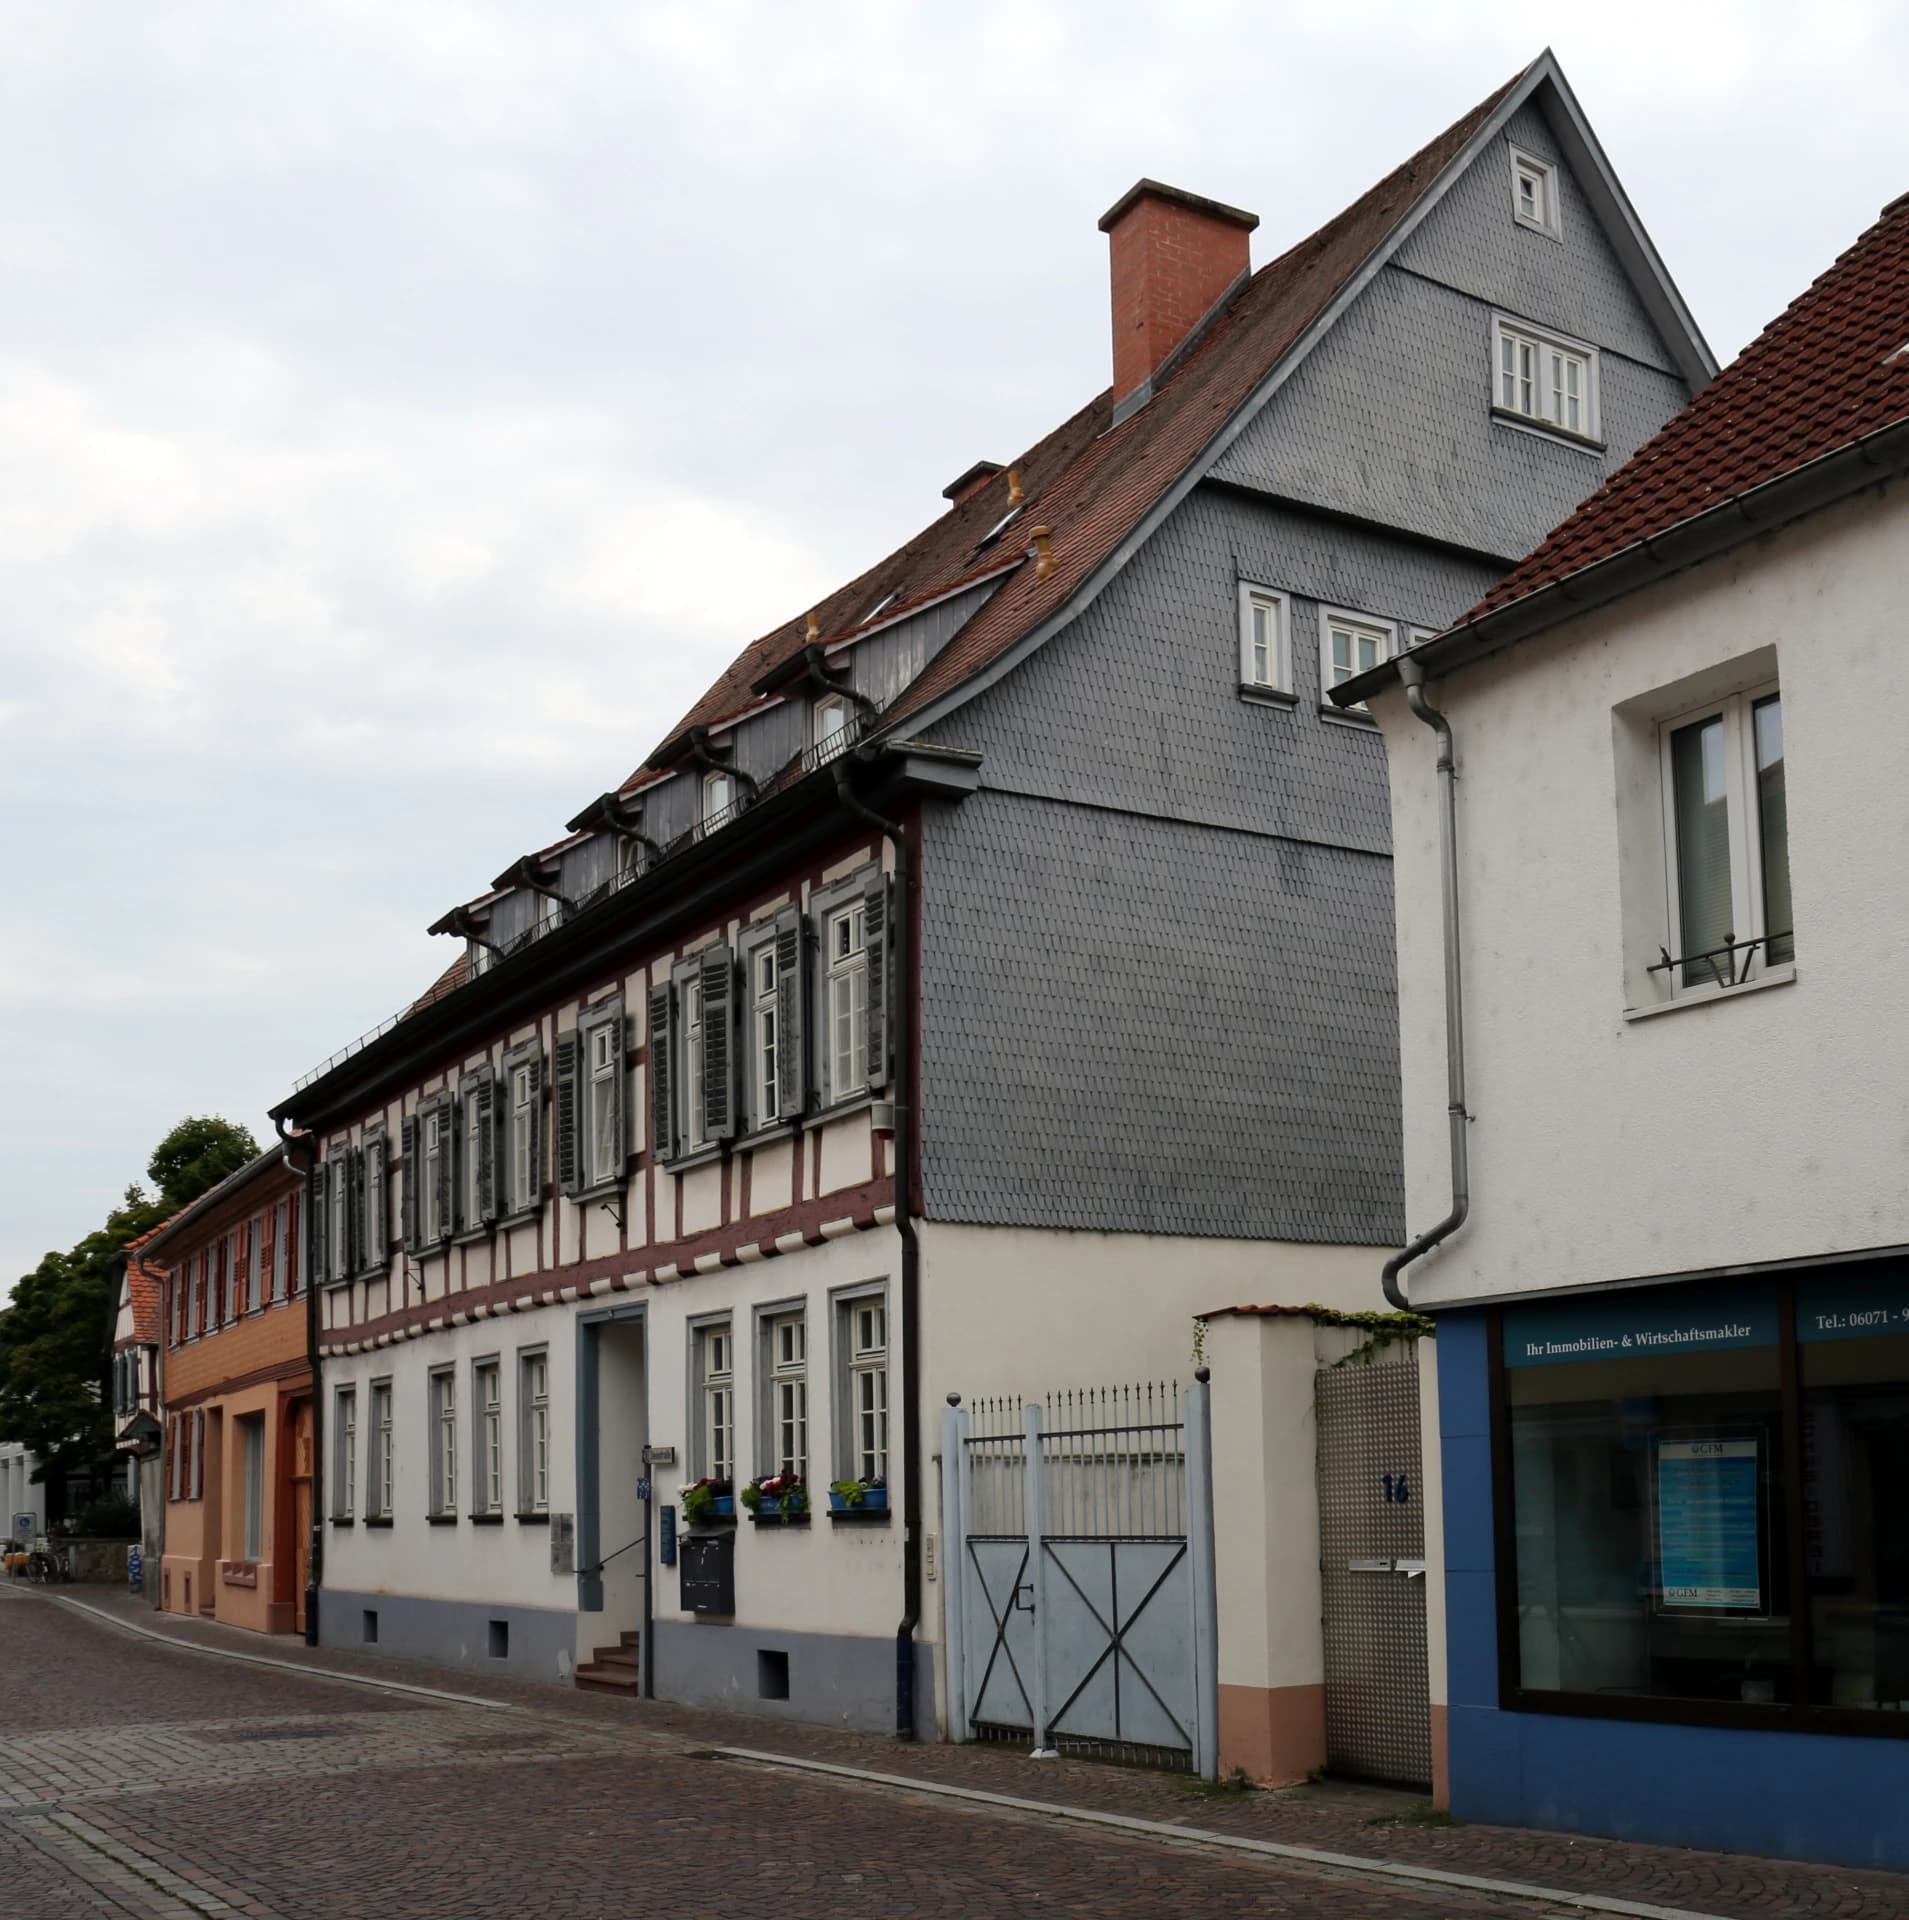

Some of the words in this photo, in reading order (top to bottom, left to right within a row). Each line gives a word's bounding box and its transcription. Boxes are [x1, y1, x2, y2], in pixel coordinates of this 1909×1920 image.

[1815, 1313, 1846, 1329] Tel.:
[1849, 1310, 1888, 1327] 06071
[1526, 1343, 1545, 1356] Ihr
[1546, 1336, 1618, 1354] Immobilien-
[1621, 1334, 1633, 1347] &
[1635, 1324, 1751, 1345] Wirtschaftsmakler
[1383, 1474, 1409, 1504] 16
